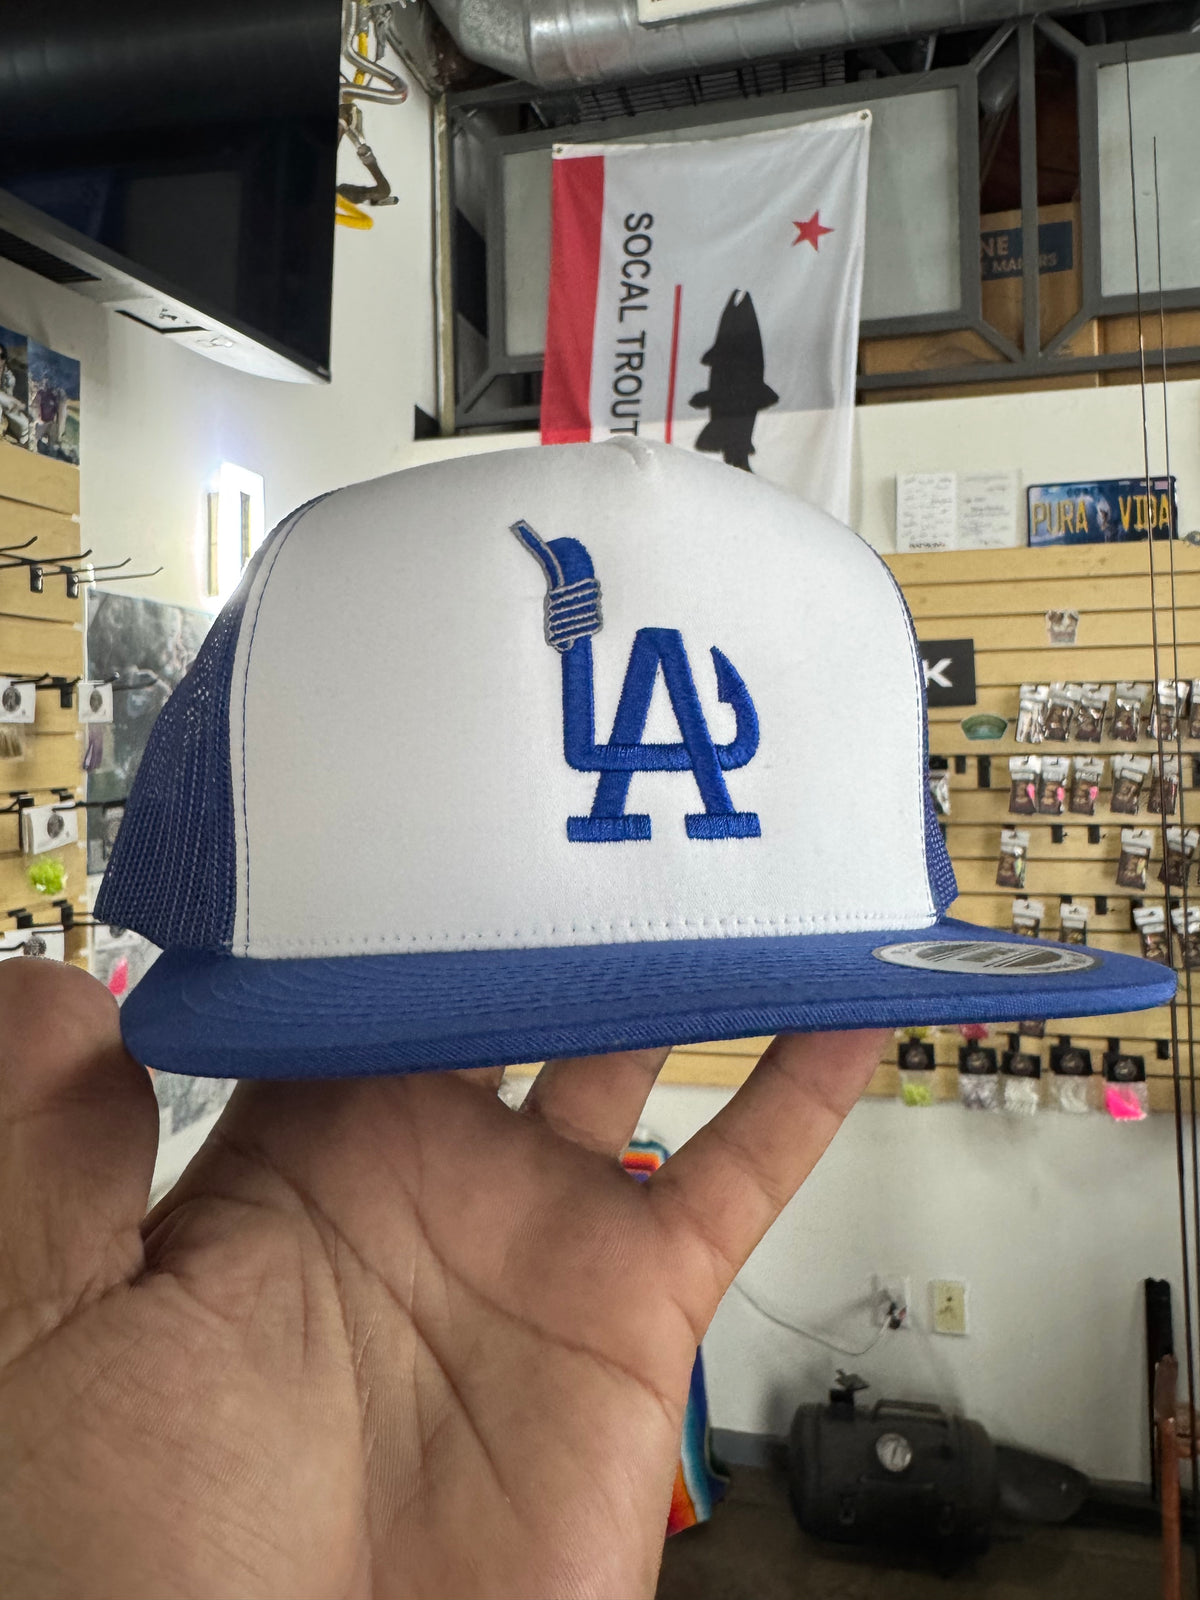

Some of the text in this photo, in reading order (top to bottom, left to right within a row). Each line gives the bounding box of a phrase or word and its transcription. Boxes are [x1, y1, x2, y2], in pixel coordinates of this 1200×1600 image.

[609, 212, 654, 436] SOCAL TROUT
[1031, 499, 1089, 535] PURA
[1118, 493, 1171, 532] VIDA
[510, 519, 761, 843] LA
